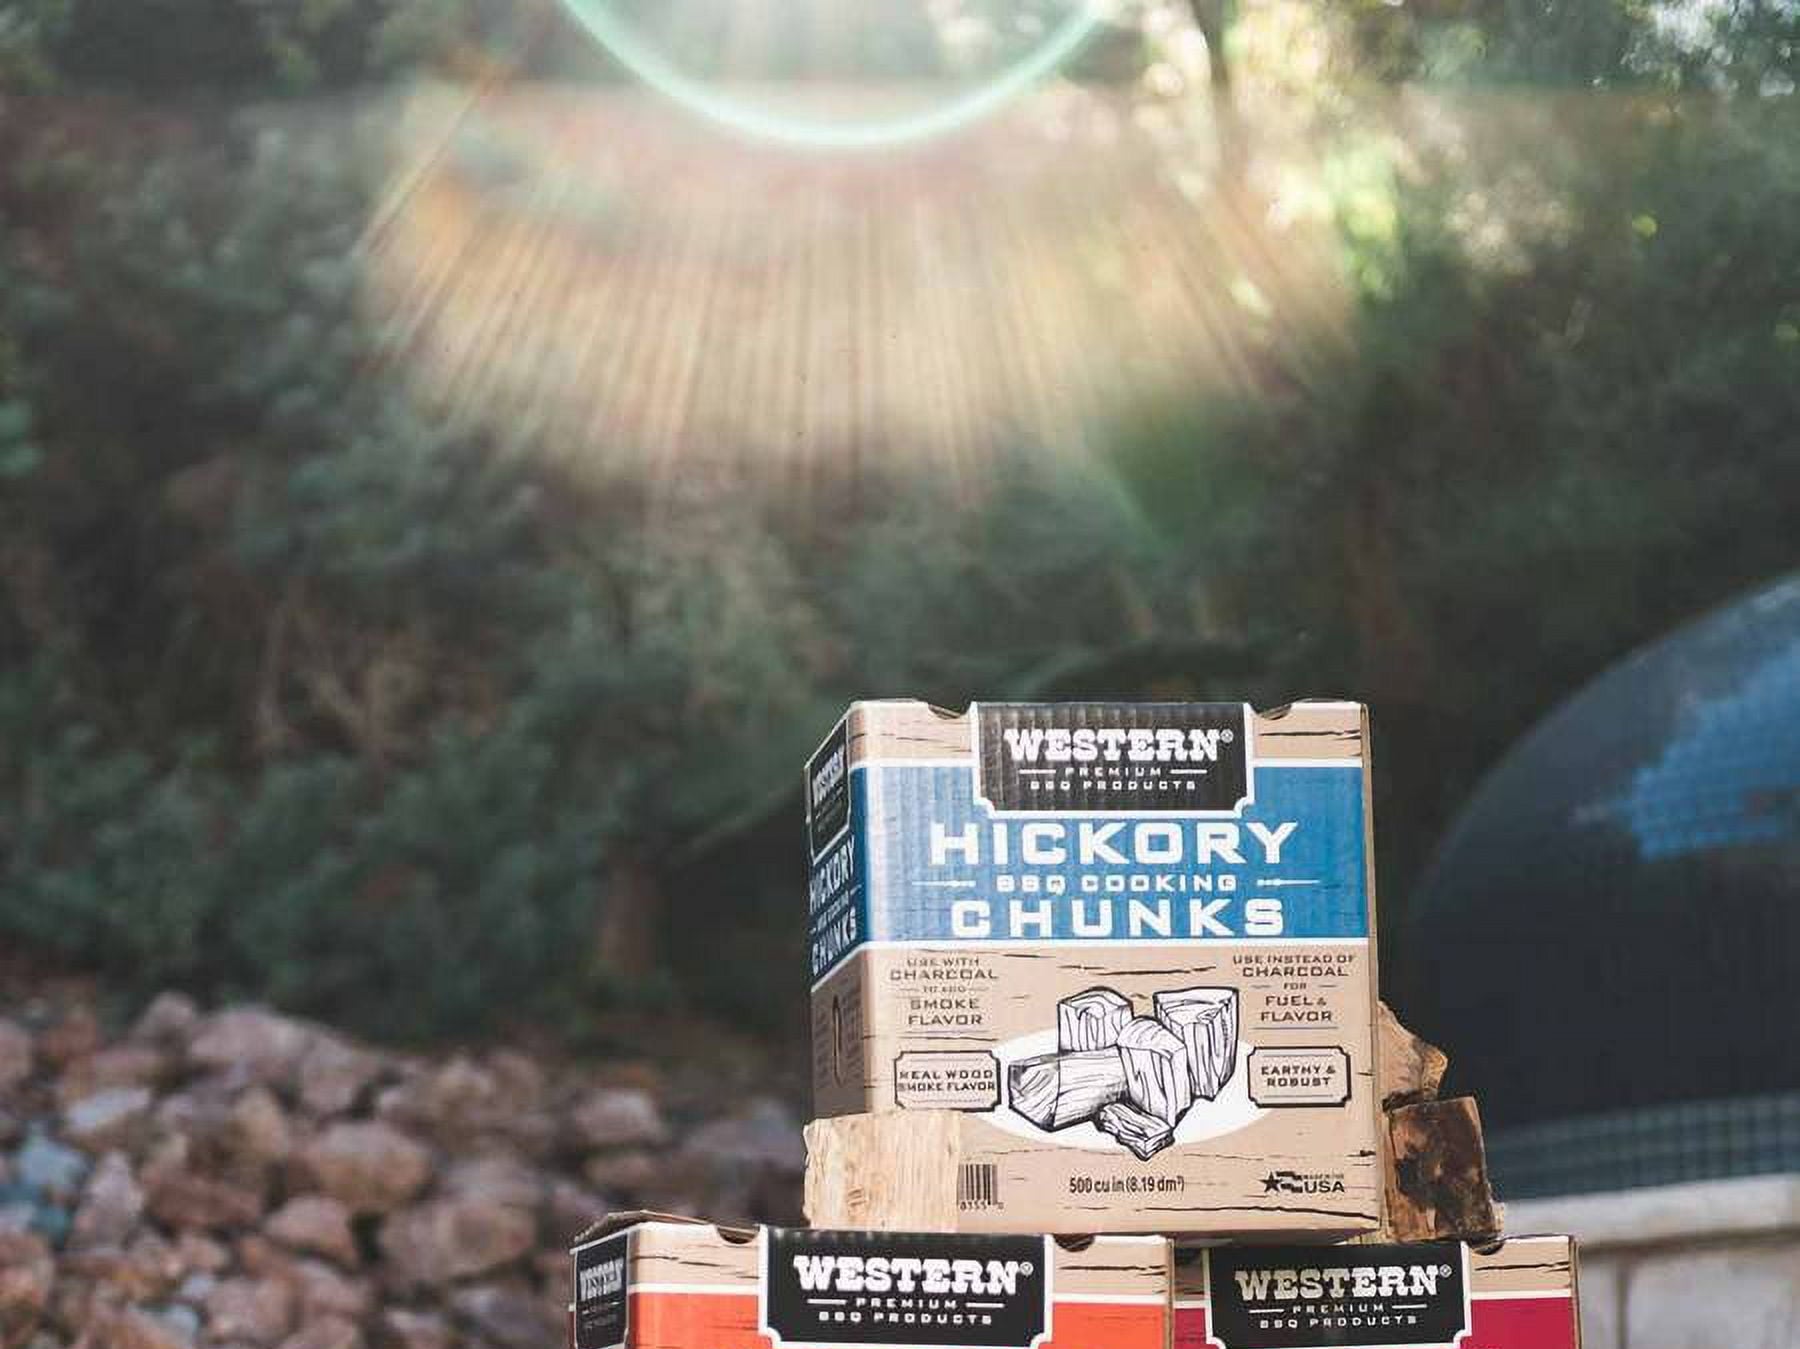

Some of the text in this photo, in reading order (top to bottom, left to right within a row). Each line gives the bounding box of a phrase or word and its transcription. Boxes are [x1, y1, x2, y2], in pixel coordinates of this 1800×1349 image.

[1065, 767, 1162, 777] PREMIUM
[1031, 781, 1196, 790] BBQ PRODUCTS
[930, 821, 1298, 865] HICKORY
[996, 874, 1238, 895] BBQ COOKING
[951, 898, 1284, 937] CHUNKS
[1267, 955, 1333, 964] INSTEAD
[890, 969, 999, 980] CHARCOAL
[1243, 966, 1349, 977] CHARCOAL
[910, 999, 980, 1010] SMOKE
[1265, 995, 1312, 1006] FUEL
[908, 1014, 983, 1025] FLAVOR
[1260, 1011, 1332, 1022] FLAVOR
[945, 1070, 994, 1080] WOOD
[1267, 1077, 1331, 1087] ROBUST
[1069, 1176, 1093, 1194] 500
[1093, 1180, 1110, 1193] cu
[1111, 1177, 1125, 1193] in
[1125, 1175, 1155, 1194] (8.19
[1303, 1180, 1345, 1194] USA
[856, 1298, 958, 1309] PREMIUM
[1293, 1303, 1384, 1313] PREMIUM
[819, 1311, 993, 1325] BBQ PRODUCTS
[1260, 1315, 1417, 1329] BBQ PRODUCTS
